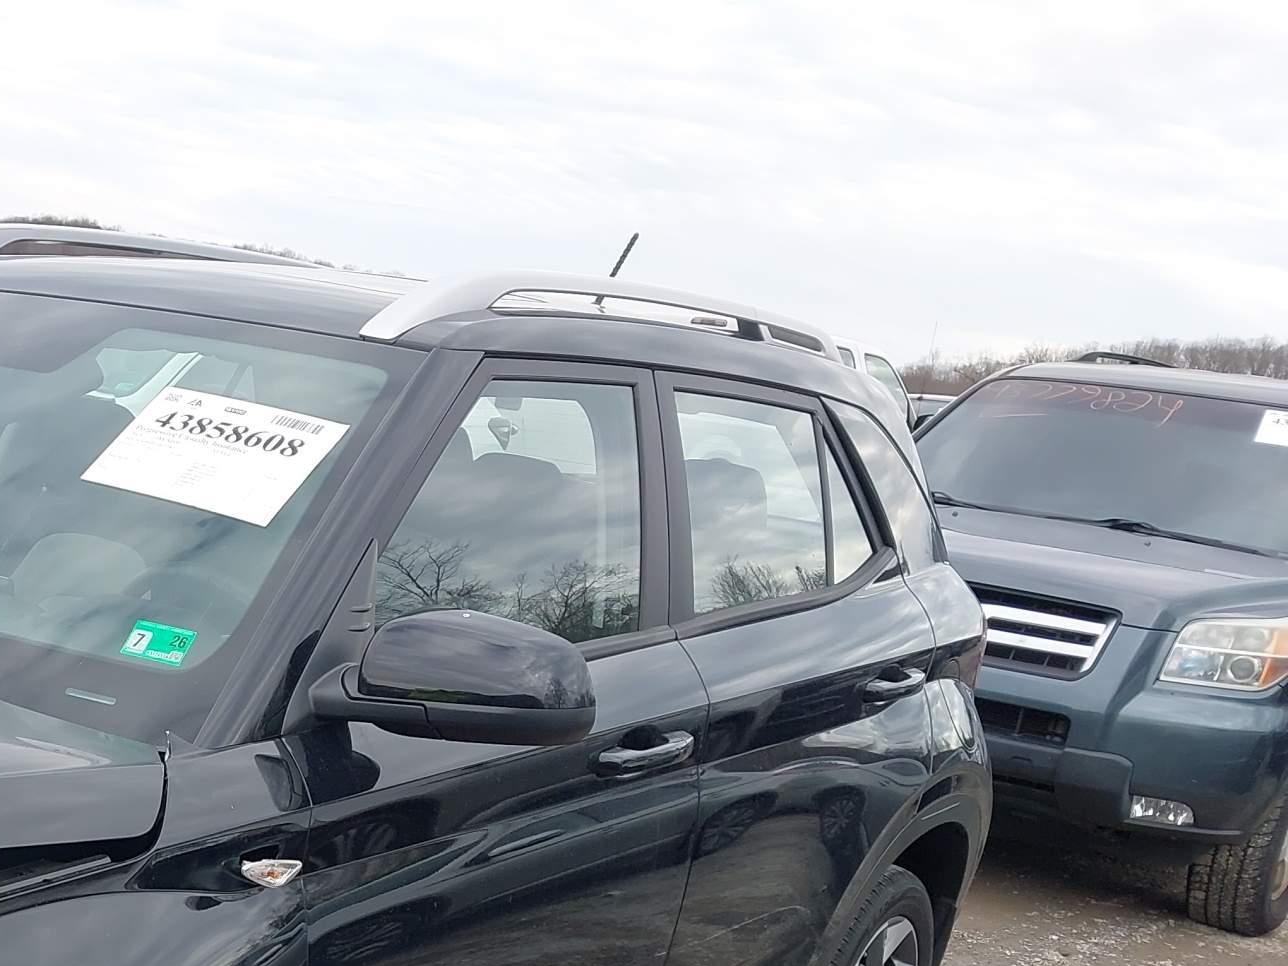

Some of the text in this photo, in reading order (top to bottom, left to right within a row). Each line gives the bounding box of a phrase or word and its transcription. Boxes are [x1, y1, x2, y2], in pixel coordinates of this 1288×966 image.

[155, 411, 305, 457] 43858608
[132, 633, 189, 649] 7 26
